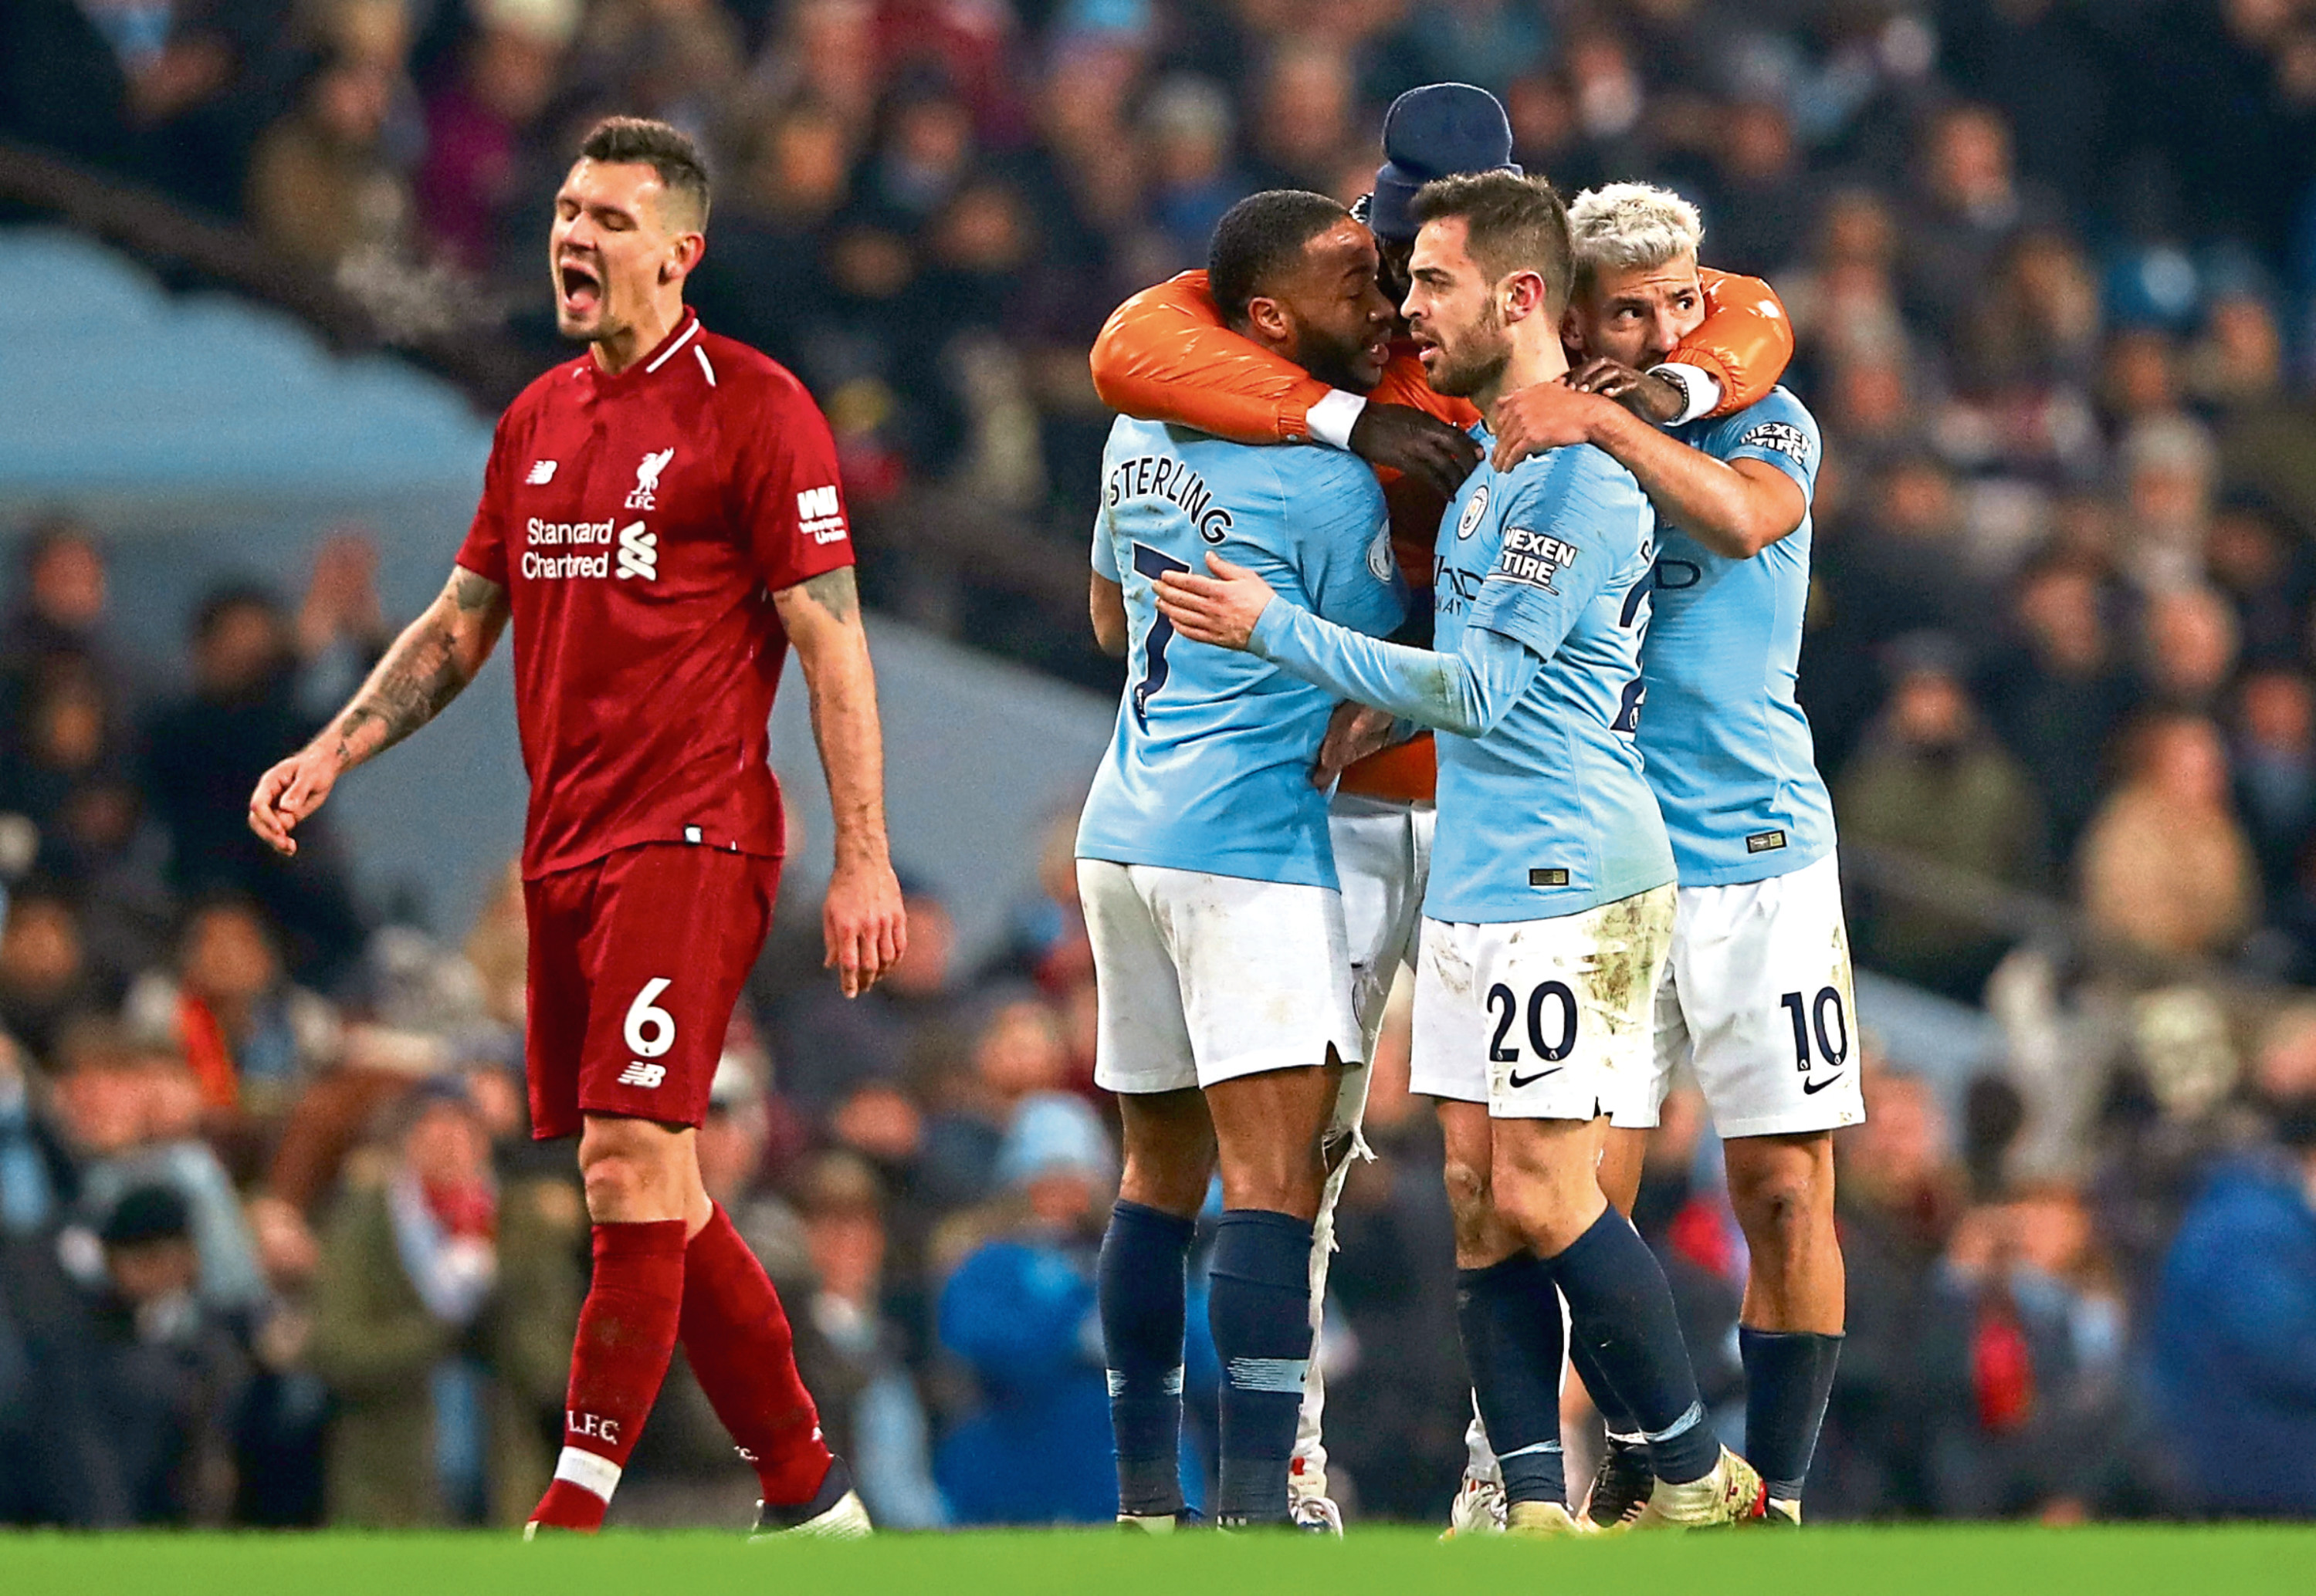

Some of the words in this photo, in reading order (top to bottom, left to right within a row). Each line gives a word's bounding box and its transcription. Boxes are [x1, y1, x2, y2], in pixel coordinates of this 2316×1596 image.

[1740, 423, 1813, 456] NEXEN
[624, 495, 656, 511] LFC
[1109, 457, 1232, 543] STERLING
[521, 551, 609, 580] Chartred
[1502, 550, 1556, 584] TIRE
[1504, 527, 1576, 568] NEXEN
[624, 977, 676, 1057] 6
[1487, 980, 1578, 1063] 20
[1780, 986, 1848, 1072] 10
